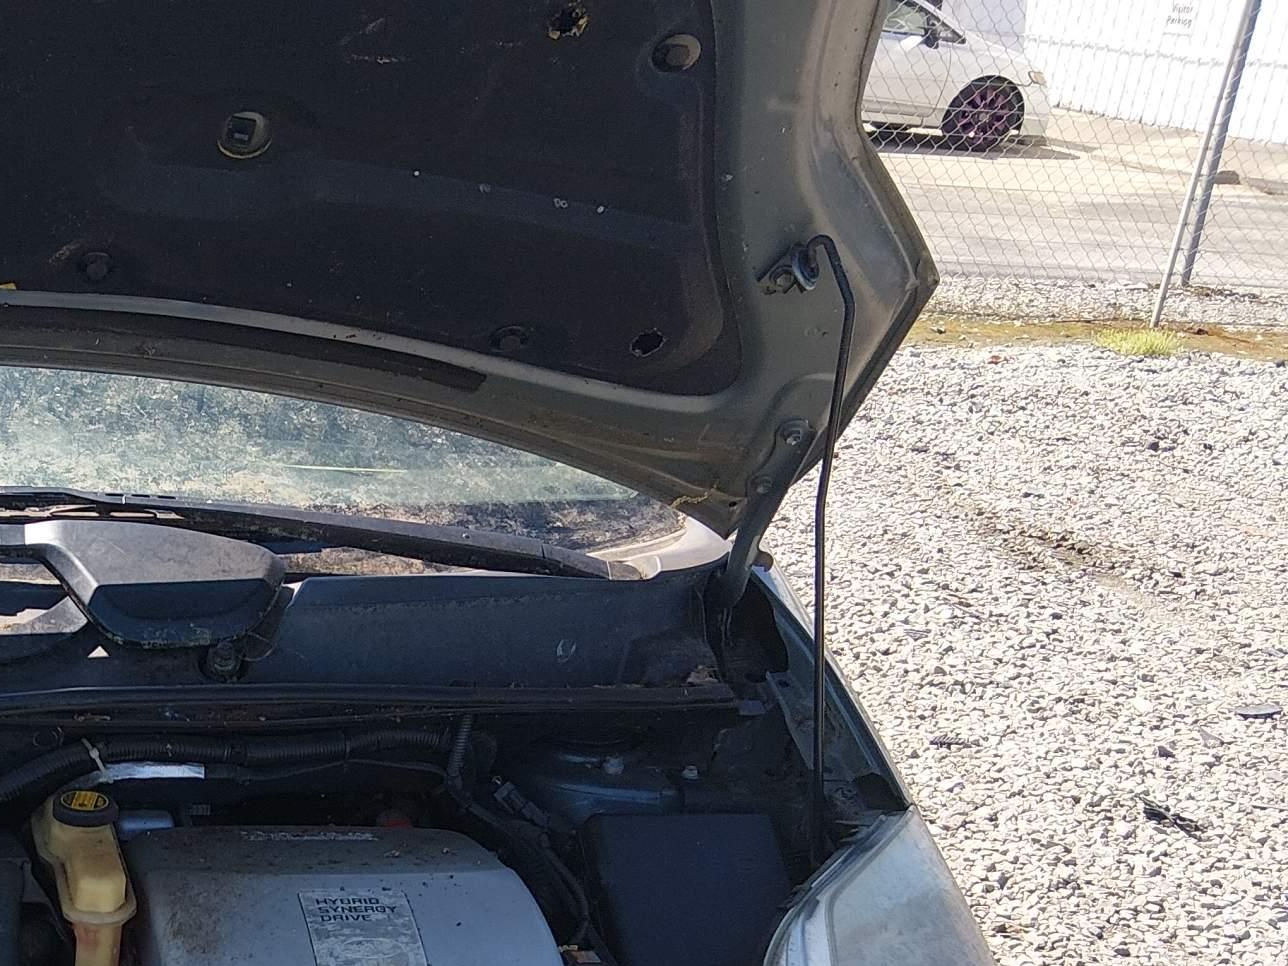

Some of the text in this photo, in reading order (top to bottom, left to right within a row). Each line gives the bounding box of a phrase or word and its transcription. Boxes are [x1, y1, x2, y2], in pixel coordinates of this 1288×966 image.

[315, 897, 380, 906] HYBRID
[317, 905, 397, 914] SYNERGY
[320, 914, 372, 922] DRIVE
